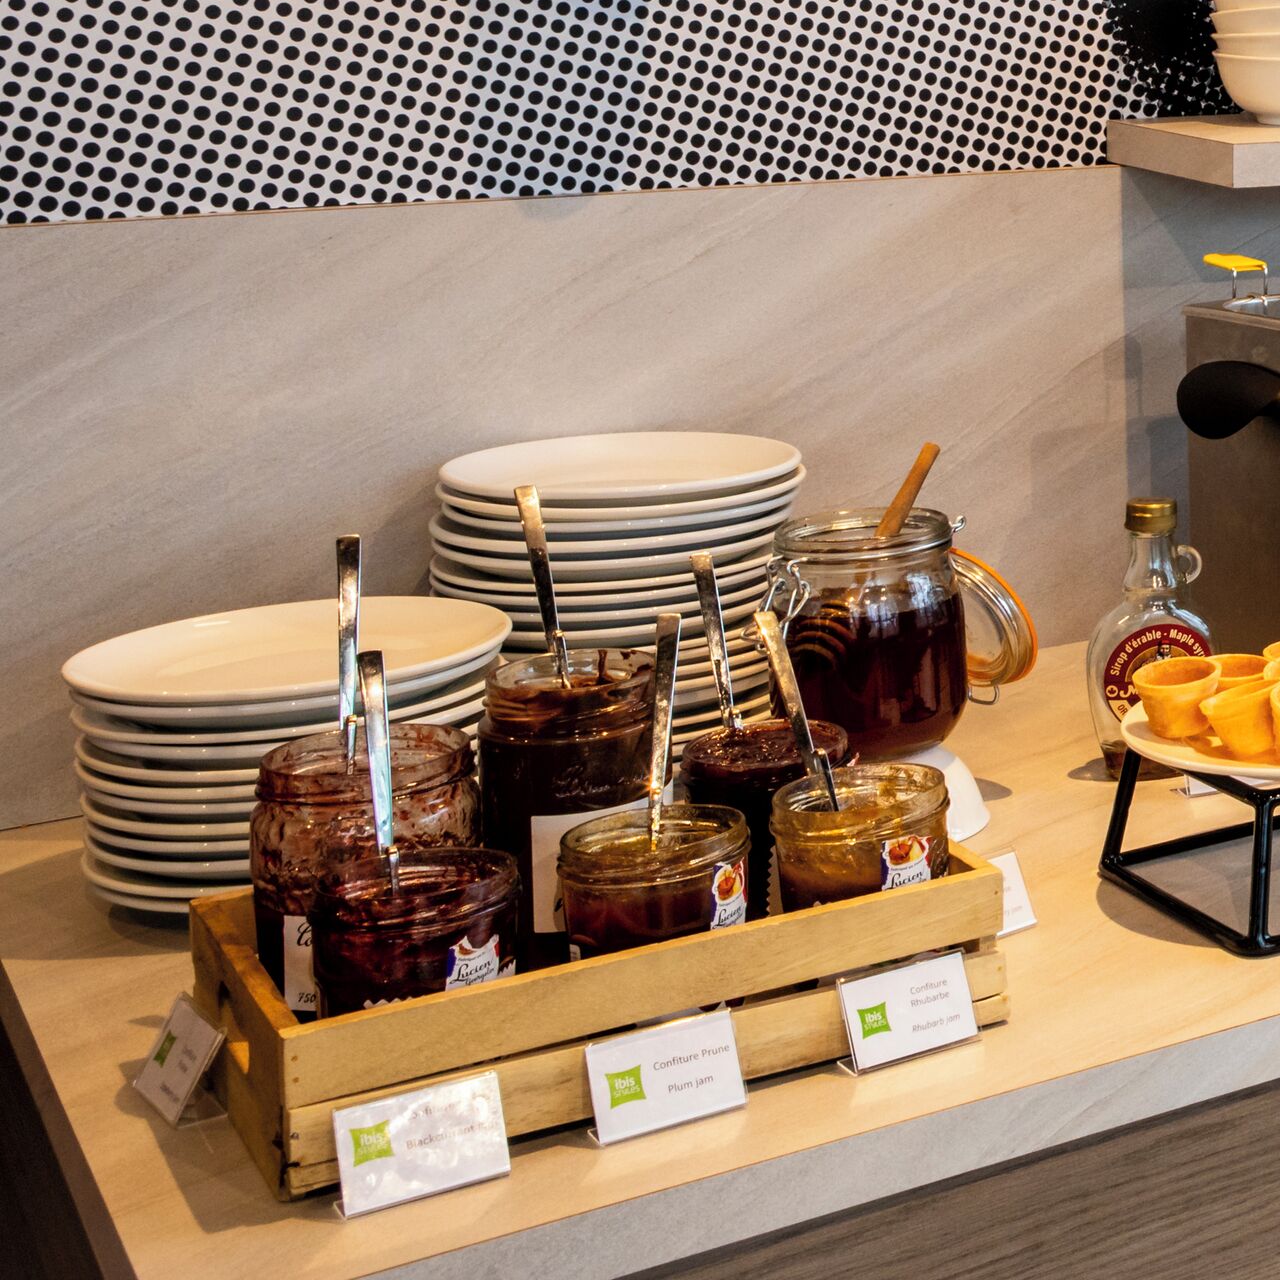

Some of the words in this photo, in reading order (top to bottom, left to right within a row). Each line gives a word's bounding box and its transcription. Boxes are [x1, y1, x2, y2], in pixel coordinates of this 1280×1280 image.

[1110, 651, 1128, 676] Sirop
[1125, 630, 1162, 654] d'érable
[1169, 628, 1195, 646] Maple
[1193, 642, 1206, 659] syr
[883, 872, 922, 891] Lucien
[712, 906, 741, 929] Lucien
[449, 960, 491, 984] Lucien
[910, 979, 948, 995] Confiture
[298, 992, 317, 1004] 750
[911, 991, 950, 1008] Rhubarbe
[865, 1012, 882, 1023] ibis
[912, 1017, 944, 1033] Rhubarb
[945, 1013, 961, 1025] jam
[653, 1053, 700, 1071] Confiture
[701, 1044, 730, 1058] Prune
[614, 1076, 635, 1090] ibis
[668, 1080, 694, 1094] Plum
[694, 1074, 714, 1089] jam
[360, 1132, 385, 1146] ibis
